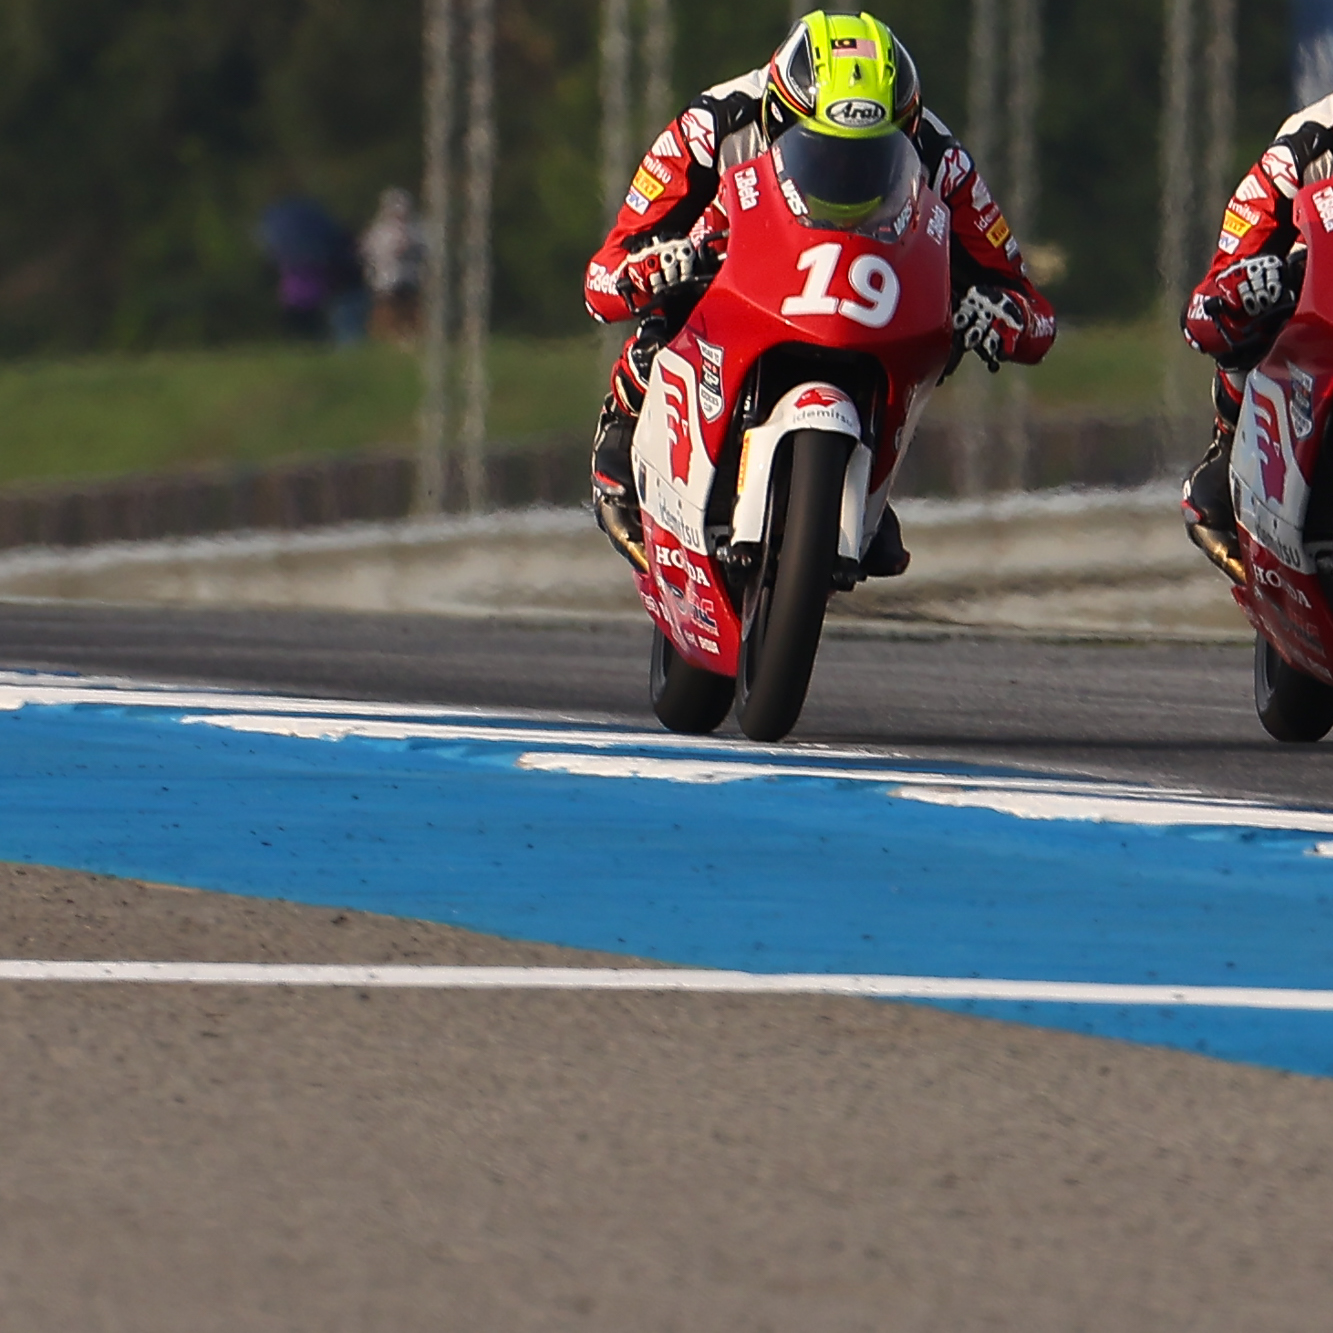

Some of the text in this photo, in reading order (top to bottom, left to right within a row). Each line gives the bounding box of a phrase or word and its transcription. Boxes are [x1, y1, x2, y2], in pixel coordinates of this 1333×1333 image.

[829, 102, 881, 118] Arai
[781, 179, 808, 215] WRS
[781, 242, 899, 328] 19
[793, 408, 853, 428] idemitsu
[1253, 564, 1312, 608] HODA
